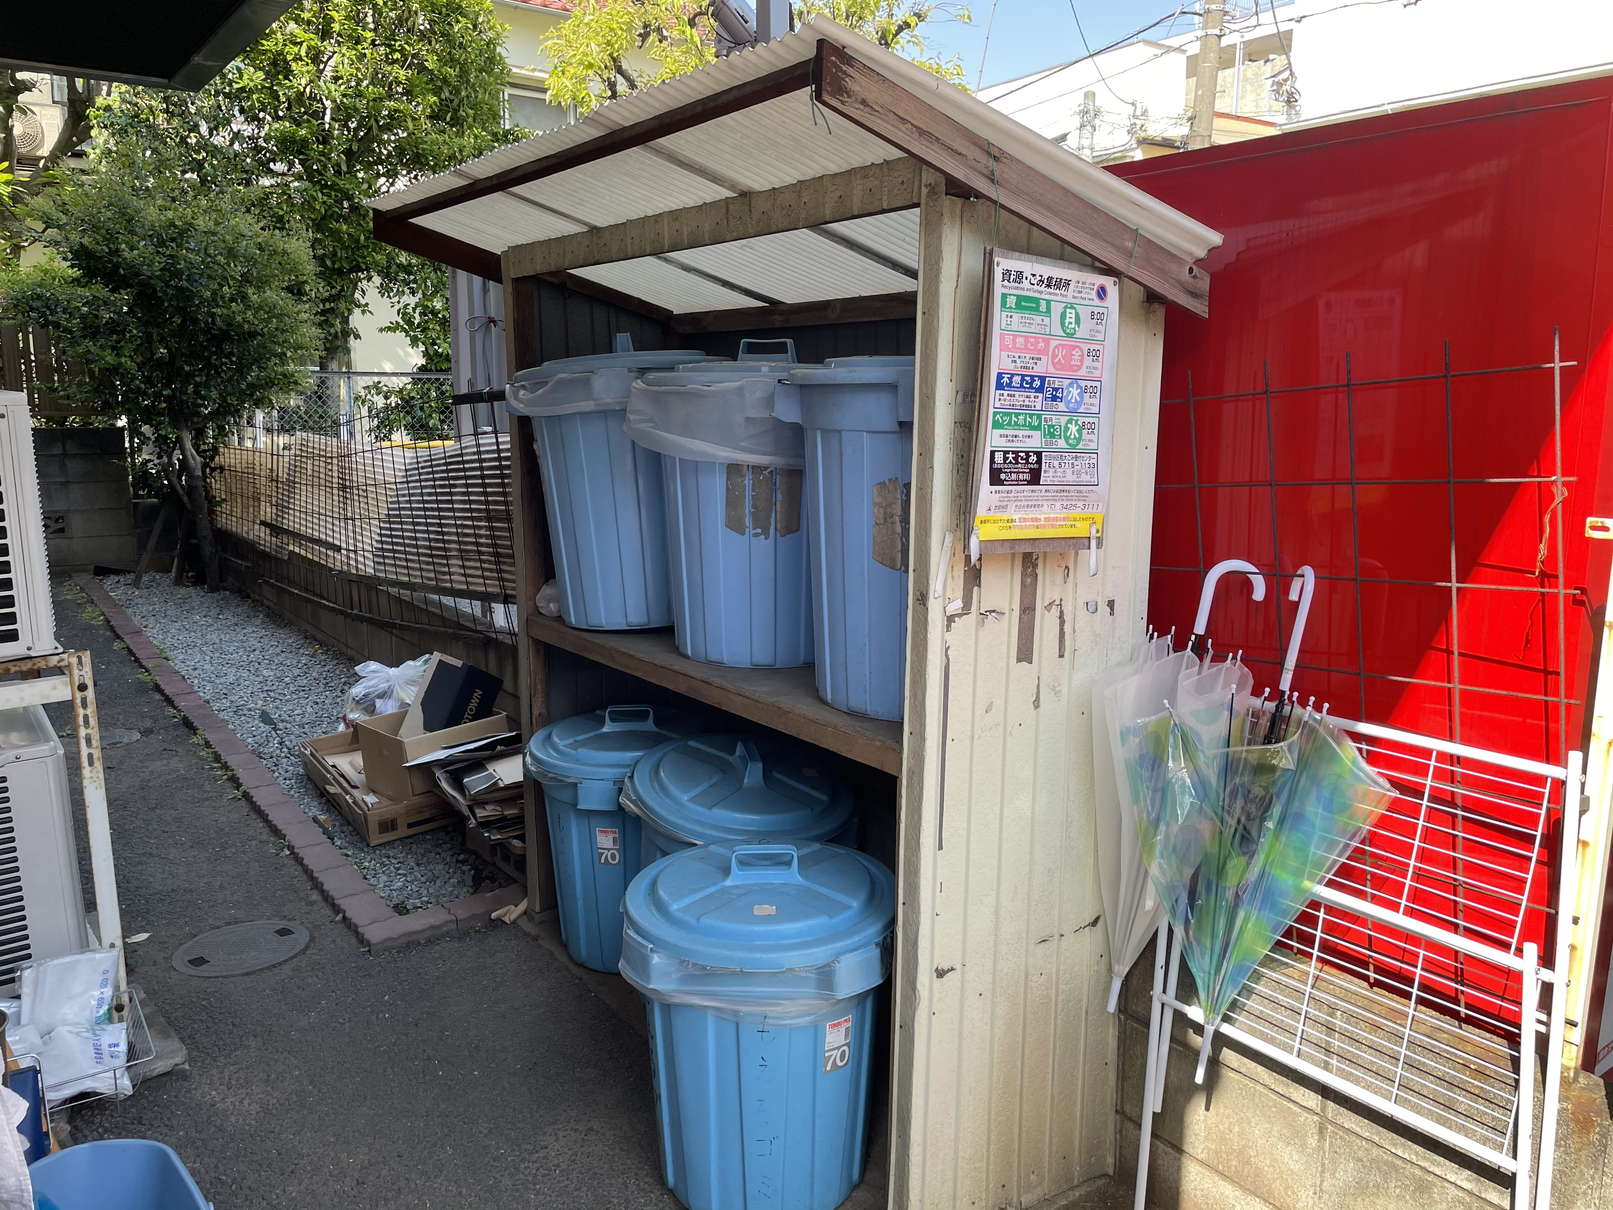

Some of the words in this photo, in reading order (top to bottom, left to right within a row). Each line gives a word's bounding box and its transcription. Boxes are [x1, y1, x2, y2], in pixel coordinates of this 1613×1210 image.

[1001, 268, 1072, 293] 資源・ごみ集積所
[1090, 311, 1105, 321] 8:00
[1004, 335, 1045, 351] 可燃ごみ
[1000, 374, 1041, 388] 不燃ごみ
[1067, 383, 1081, 403] 水
[995, 413, 1039, 426] ペットボトル
[1066, 420, 1079, 438] 水
[994, 451, 1037, 463] 粗大ごみ
[598, 849, 620, 864] 70
[825, 1045, 849, 1071] 70
